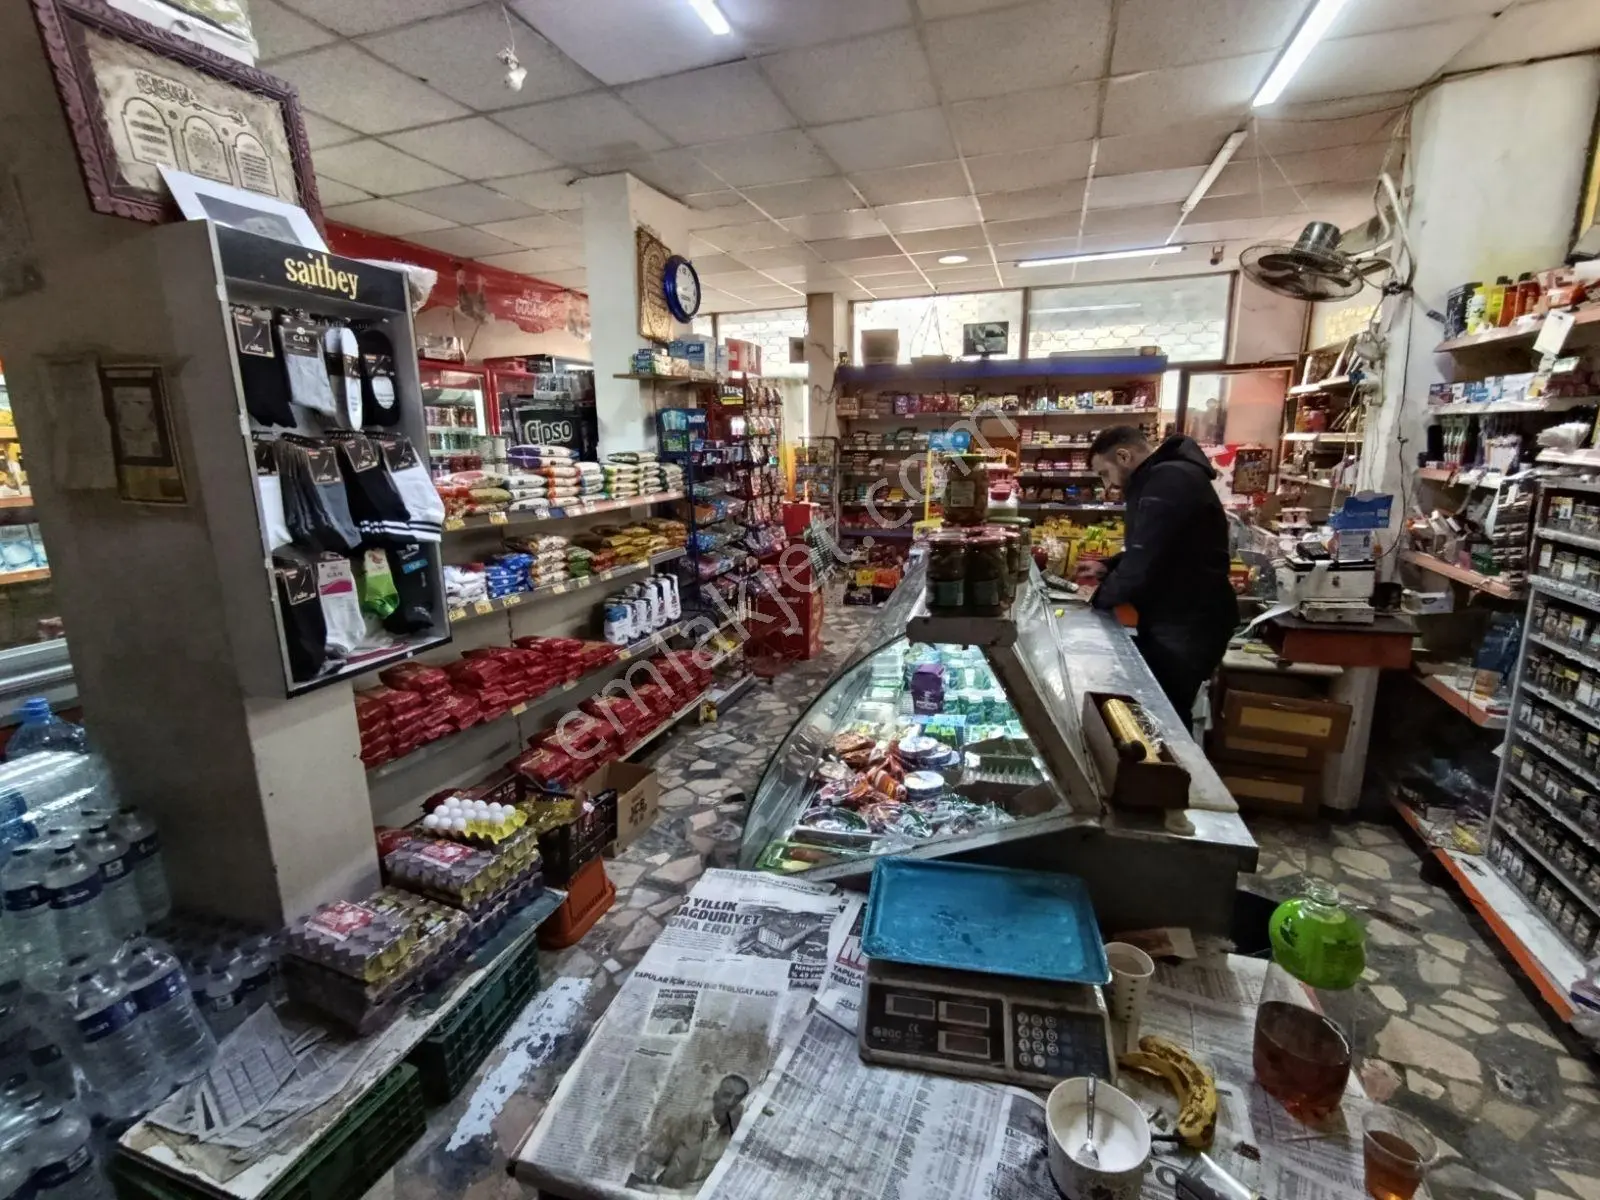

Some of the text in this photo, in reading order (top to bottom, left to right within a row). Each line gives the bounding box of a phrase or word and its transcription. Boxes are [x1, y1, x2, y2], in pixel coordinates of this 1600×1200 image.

[284, 252, 359, 300] saitbey
[292, 334, 310, 343] CAN
[524, 419, 573, 446] Cipso
[694, 897, 738, 912] YILLIK
[634, 971, 669, 984] TAPULAR
